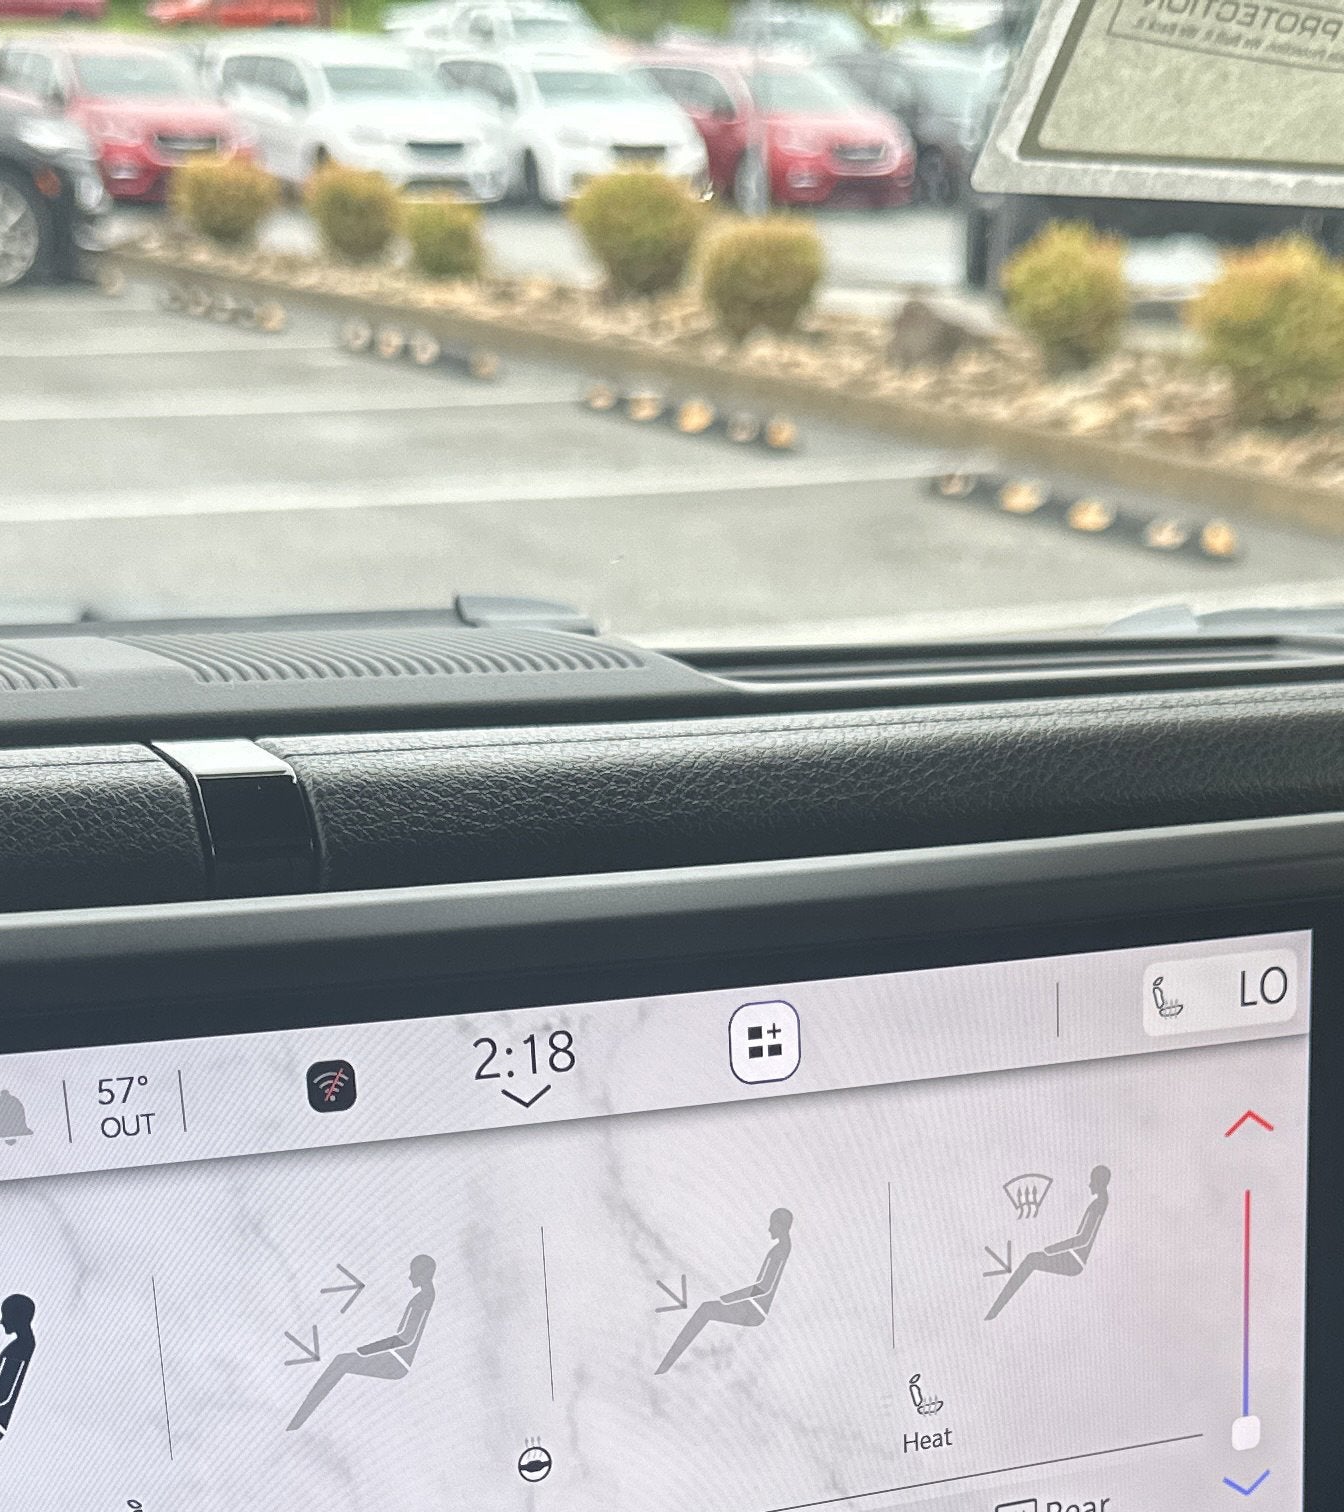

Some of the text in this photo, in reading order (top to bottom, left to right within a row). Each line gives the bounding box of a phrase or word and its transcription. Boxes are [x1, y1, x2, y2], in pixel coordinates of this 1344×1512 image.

[1240, 966, 1288, 1007] LO
[473, 1030, 575, 1080] 2:18
[98, 1075, 148, 1105] 57°
[101, 1113, 156, 1138] OUT
[903, 1427, 953, 1453] Heat
